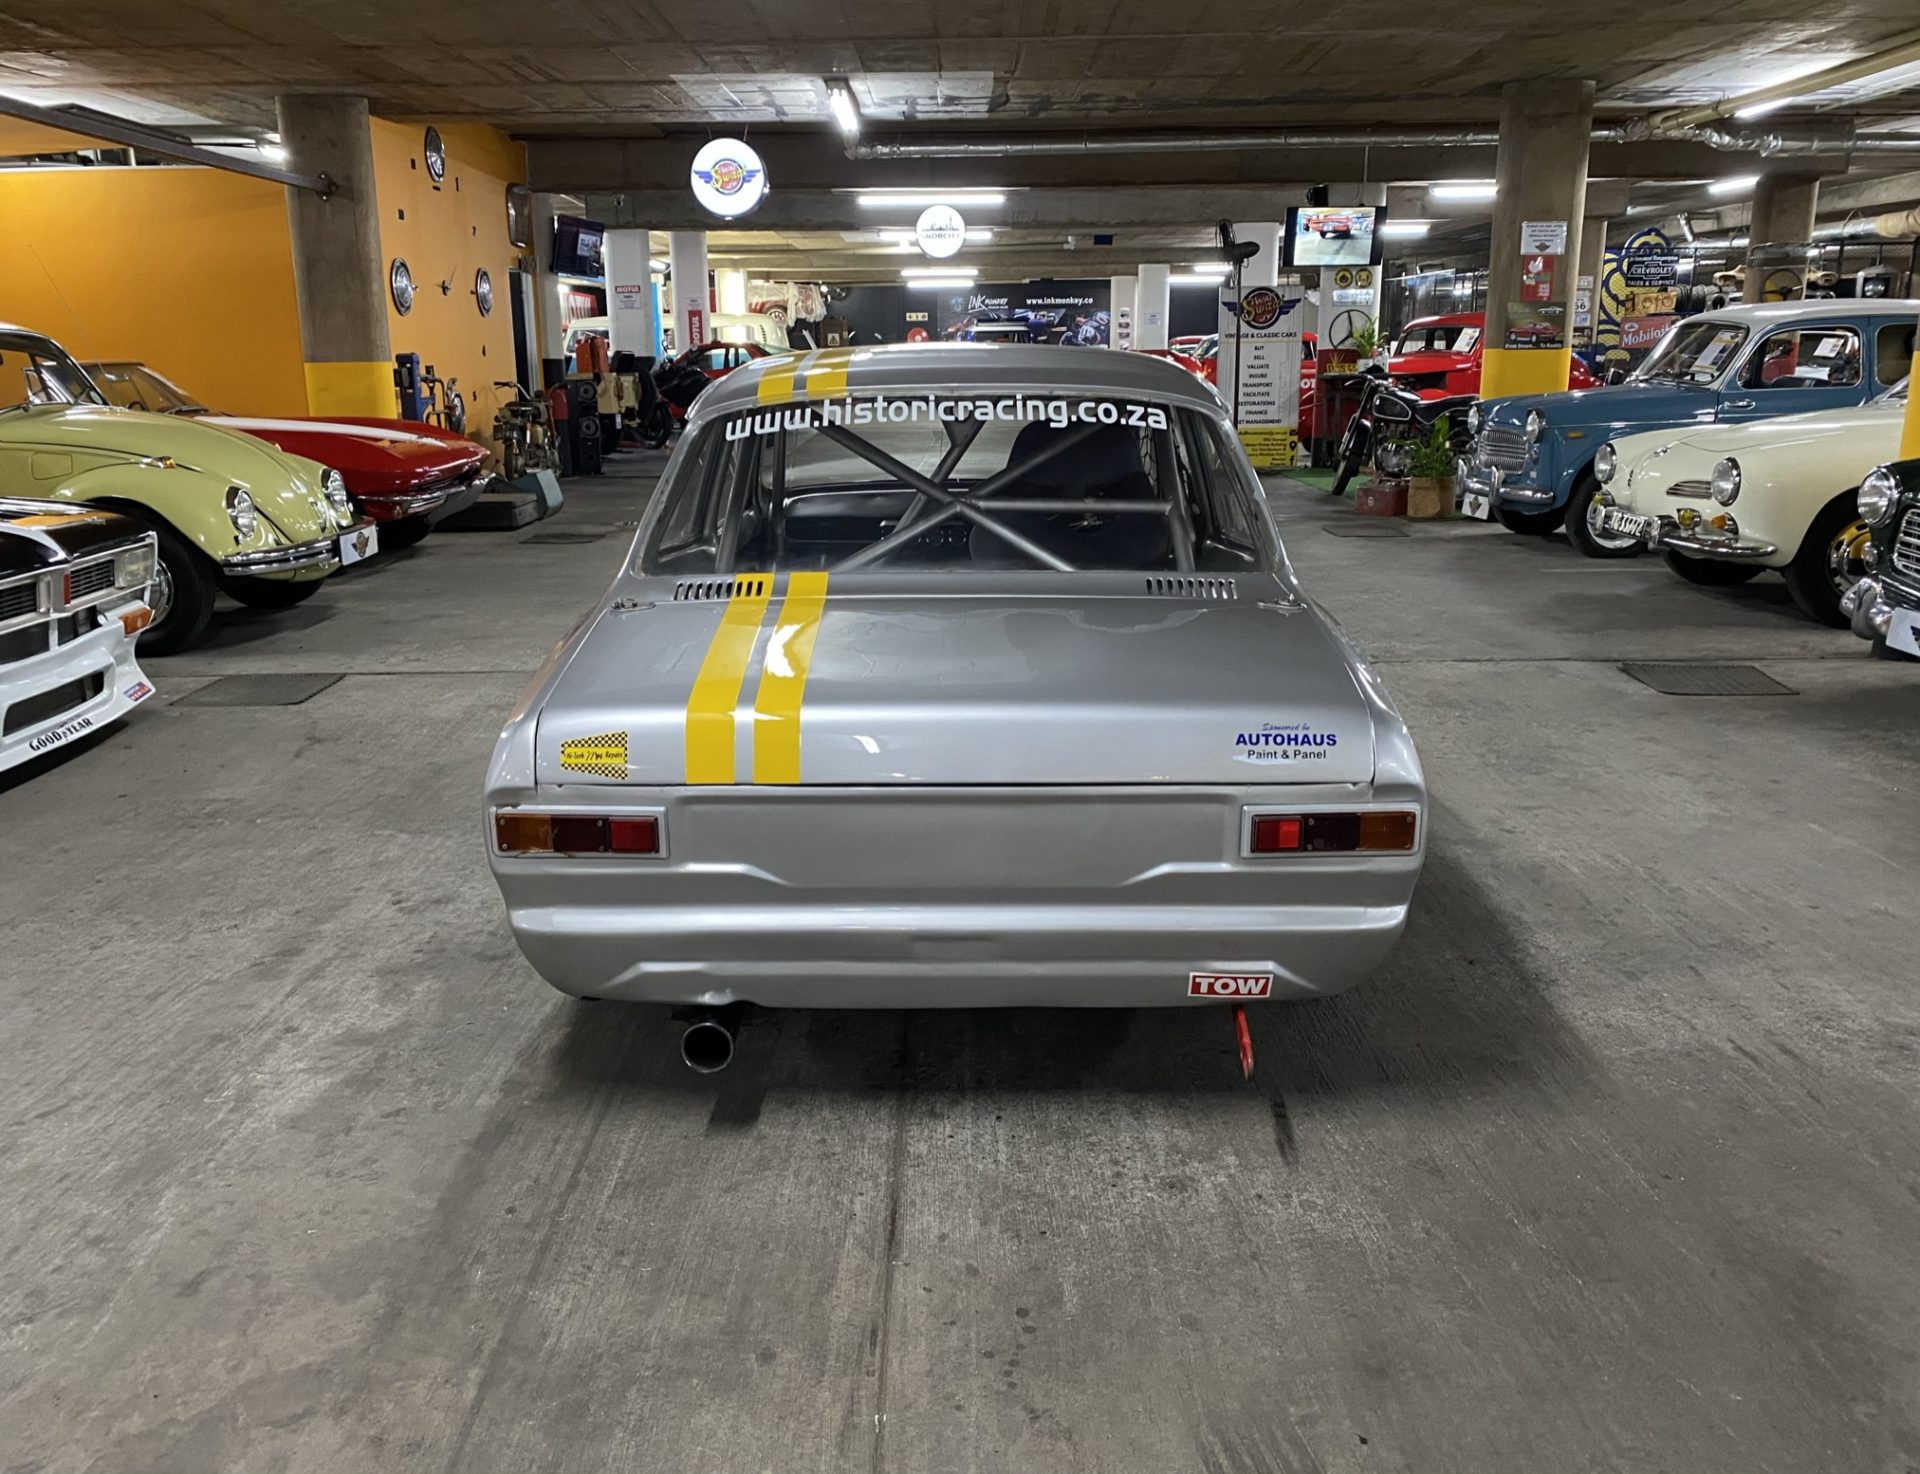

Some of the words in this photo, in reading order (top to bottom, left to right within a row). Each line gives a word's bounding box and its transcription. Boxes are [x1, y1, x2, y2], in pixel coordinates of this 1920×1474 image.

[1632, 266, 1672, 274] CHEVROLET
[725, 393, 1168, 441] www.historicracing.co.za
[1262, 723, 1300, 732] Sponsored
[1235, 733, 1337, 746] AUTOHAUS
[1247, 749, 1277, 760] Paint
[1281, 749, 1289, 760] &
[1293, 749, 1326, 760] Panel
[1195, 977, 1267, 995] TOW
